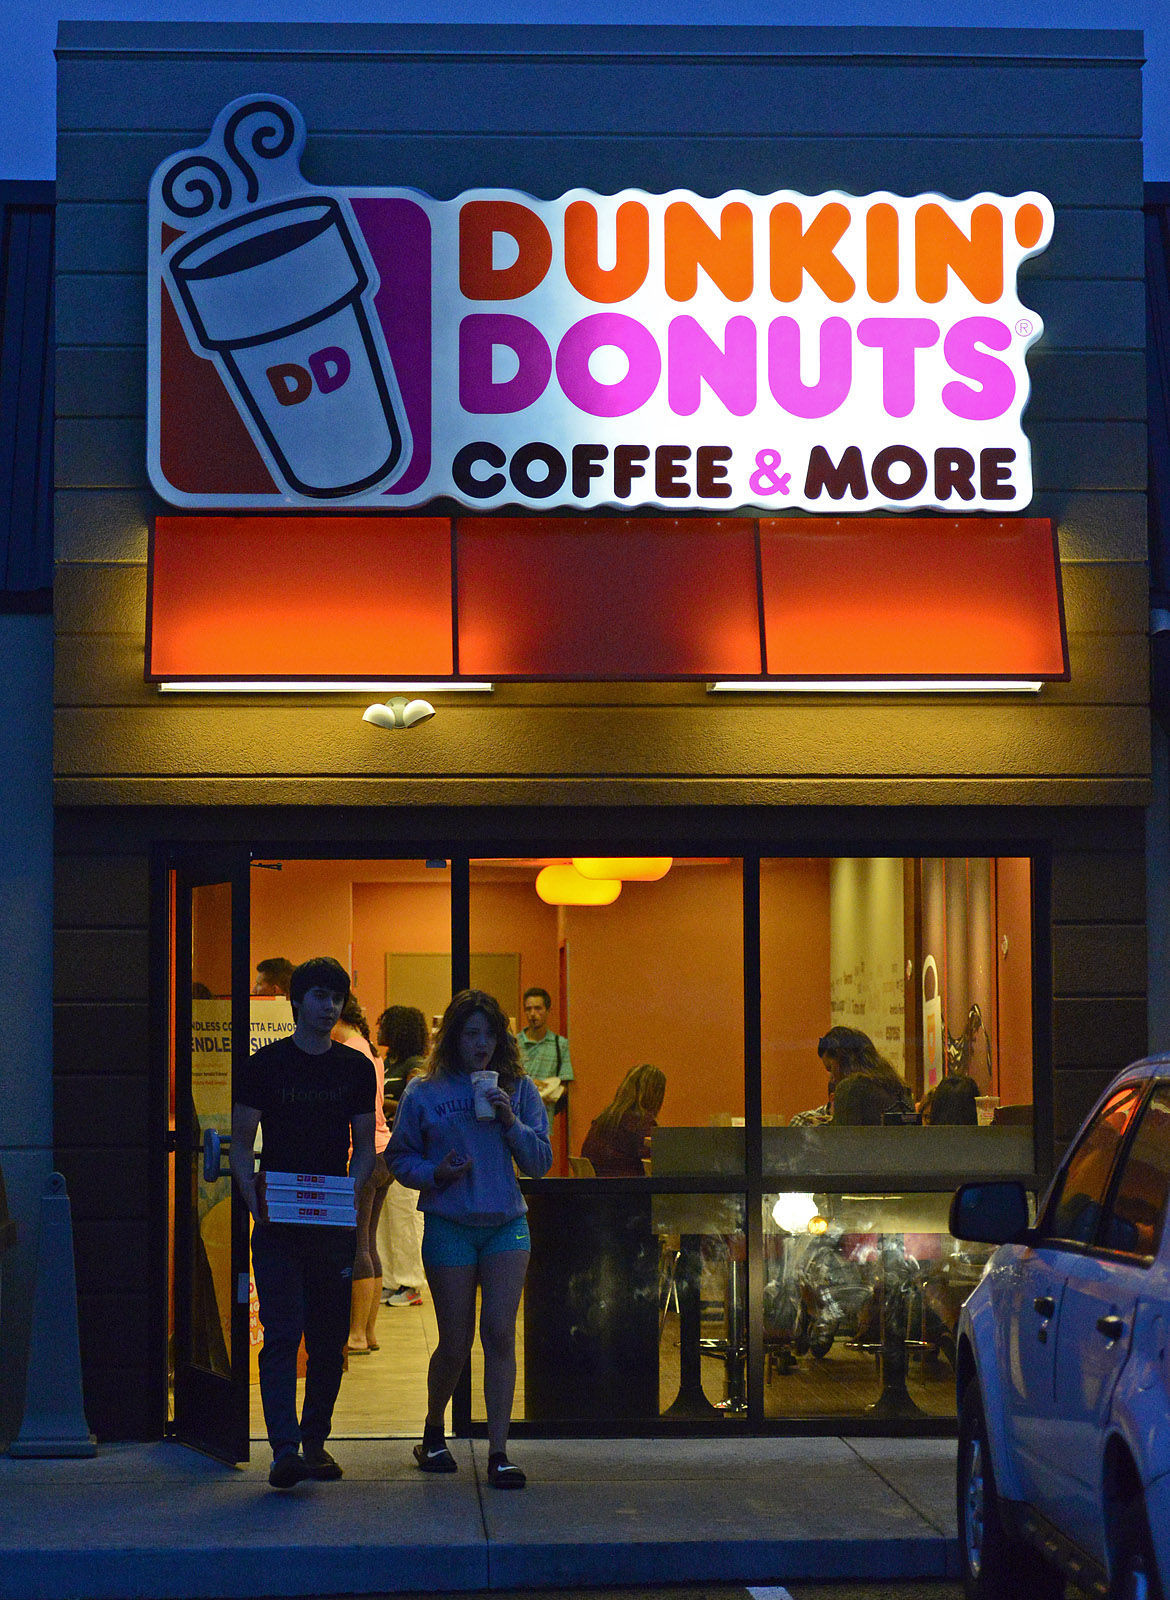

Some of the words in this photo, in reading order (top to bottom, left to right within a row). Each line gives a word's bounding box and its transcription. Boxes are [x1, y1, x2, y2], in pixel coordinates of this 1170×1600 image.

[459, 200, 1044, 304] DUNKIN'
[266, 346, 351, 406] DD
[459, 312, 1016, 421] DONUTS
[452, 441, 733, 499] COFFEE
[749, 448, 792, 496] &
[804, 444, 1017, 501] MORE
[192, 1021, 220, 1031] DLESS
